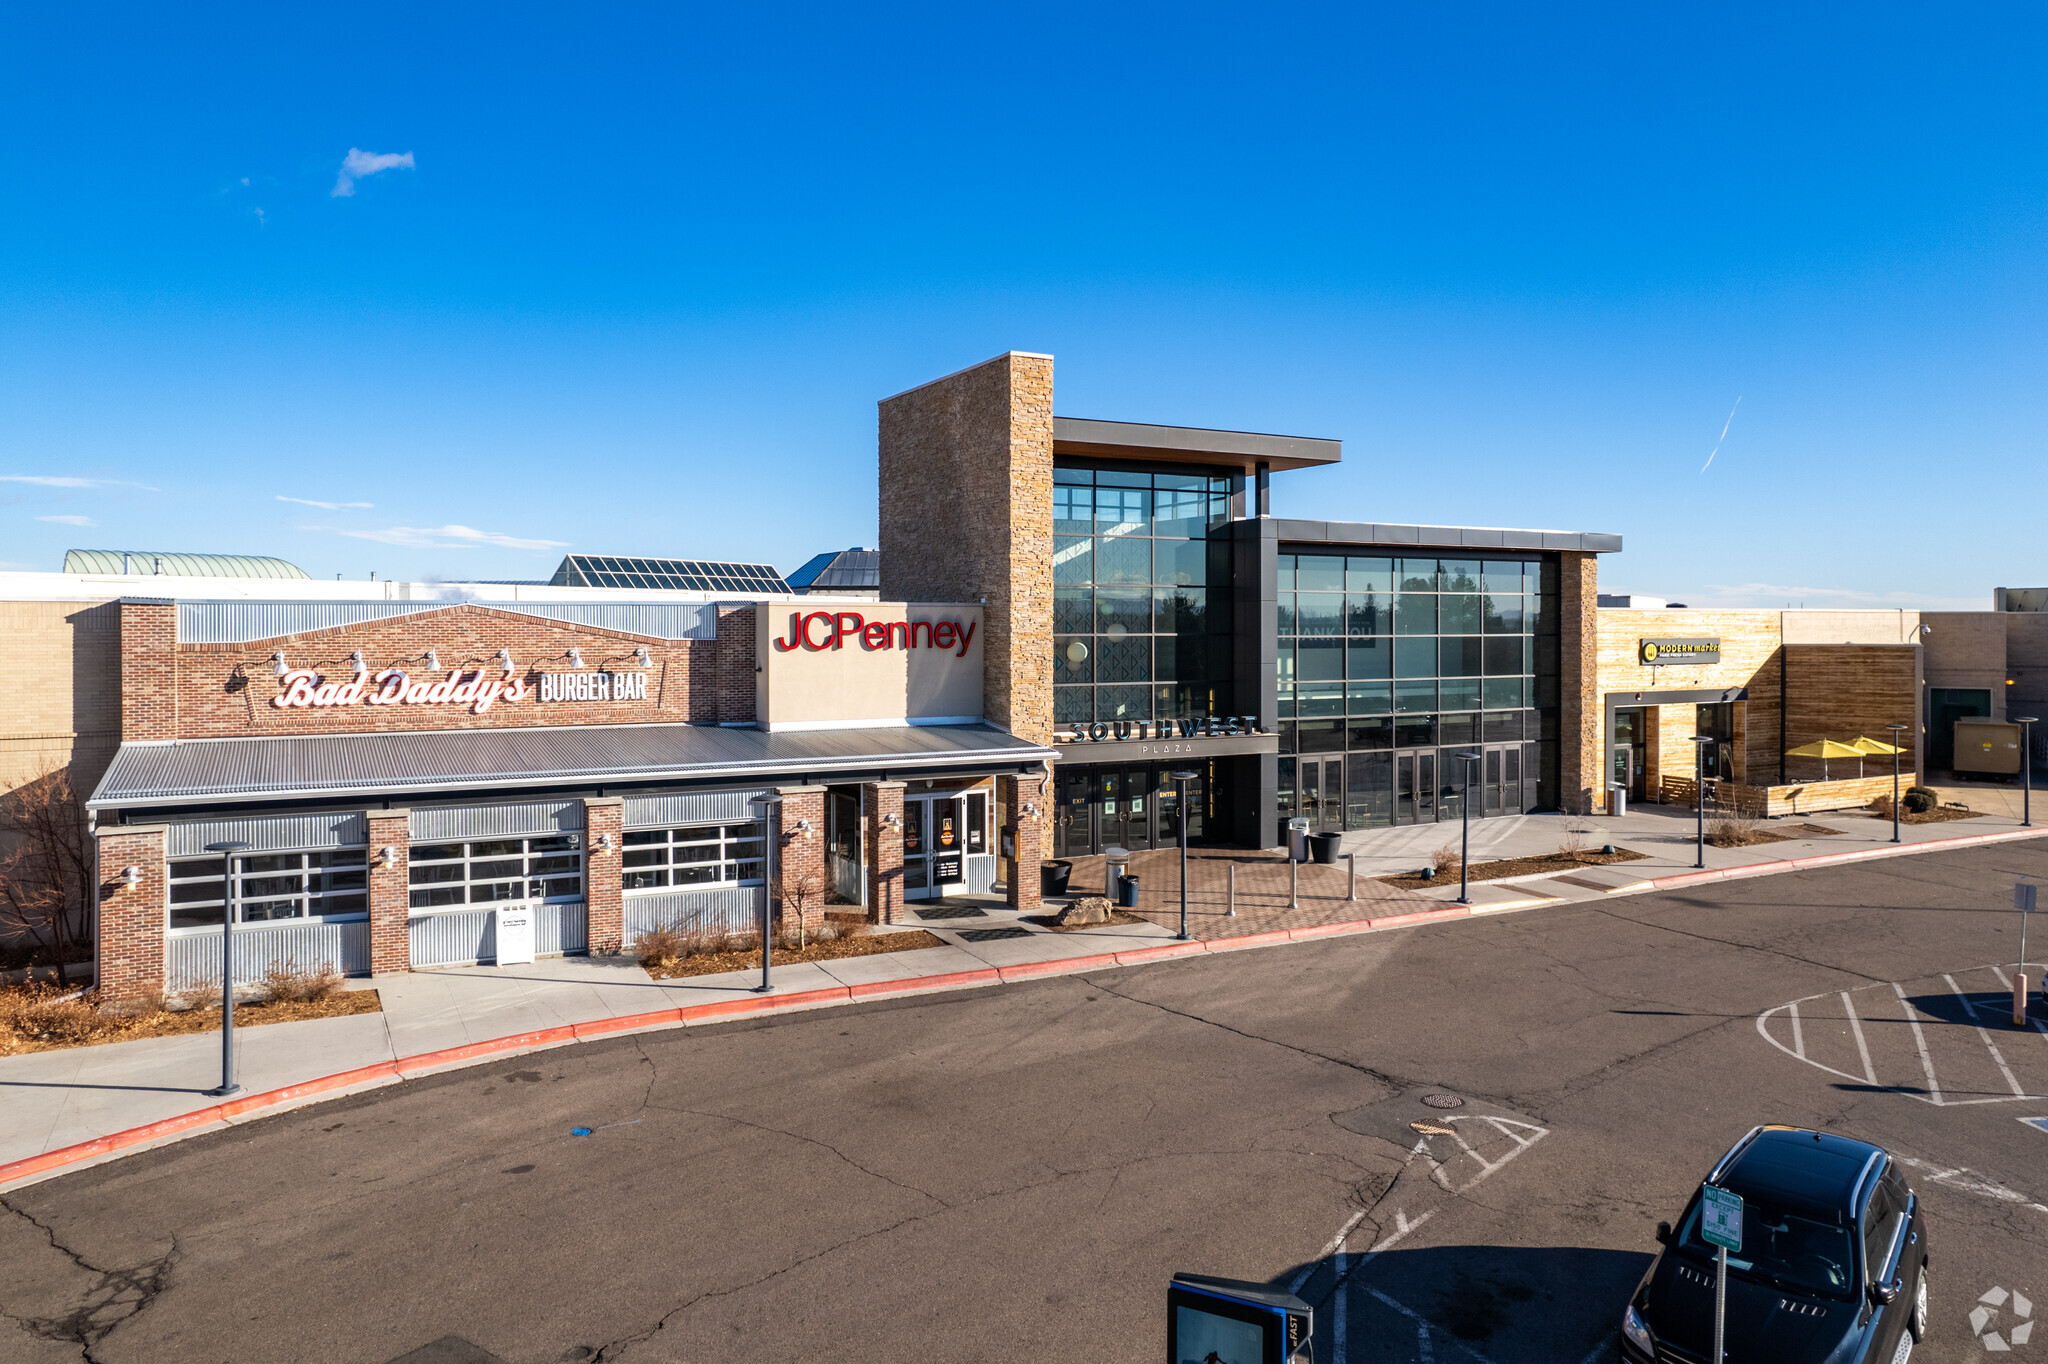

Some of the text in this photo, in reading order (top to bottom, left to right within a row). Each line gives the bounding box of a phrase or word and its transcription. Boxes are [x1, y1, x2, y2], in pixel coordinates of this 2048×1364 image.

[779, 611, 977, 657] JCPenney
[1660, 642, 1720, 652] MODERN market
[275, 668, 532, 714] Bad Daddy's
[541, 672, 647, 701] BURGER BAR
[1070, 716, 1258, 742] SOUTHWEST
[1142, 744, 1192, 754] PLAZA
[1072, 797, 1085, 805] EXIT
[1706, 1188, 1740, 1208] NO PARKING
[1711, 1202, 1734, 1214] EXCEPT
[1724, 1225, 1737, 1236] FINE
